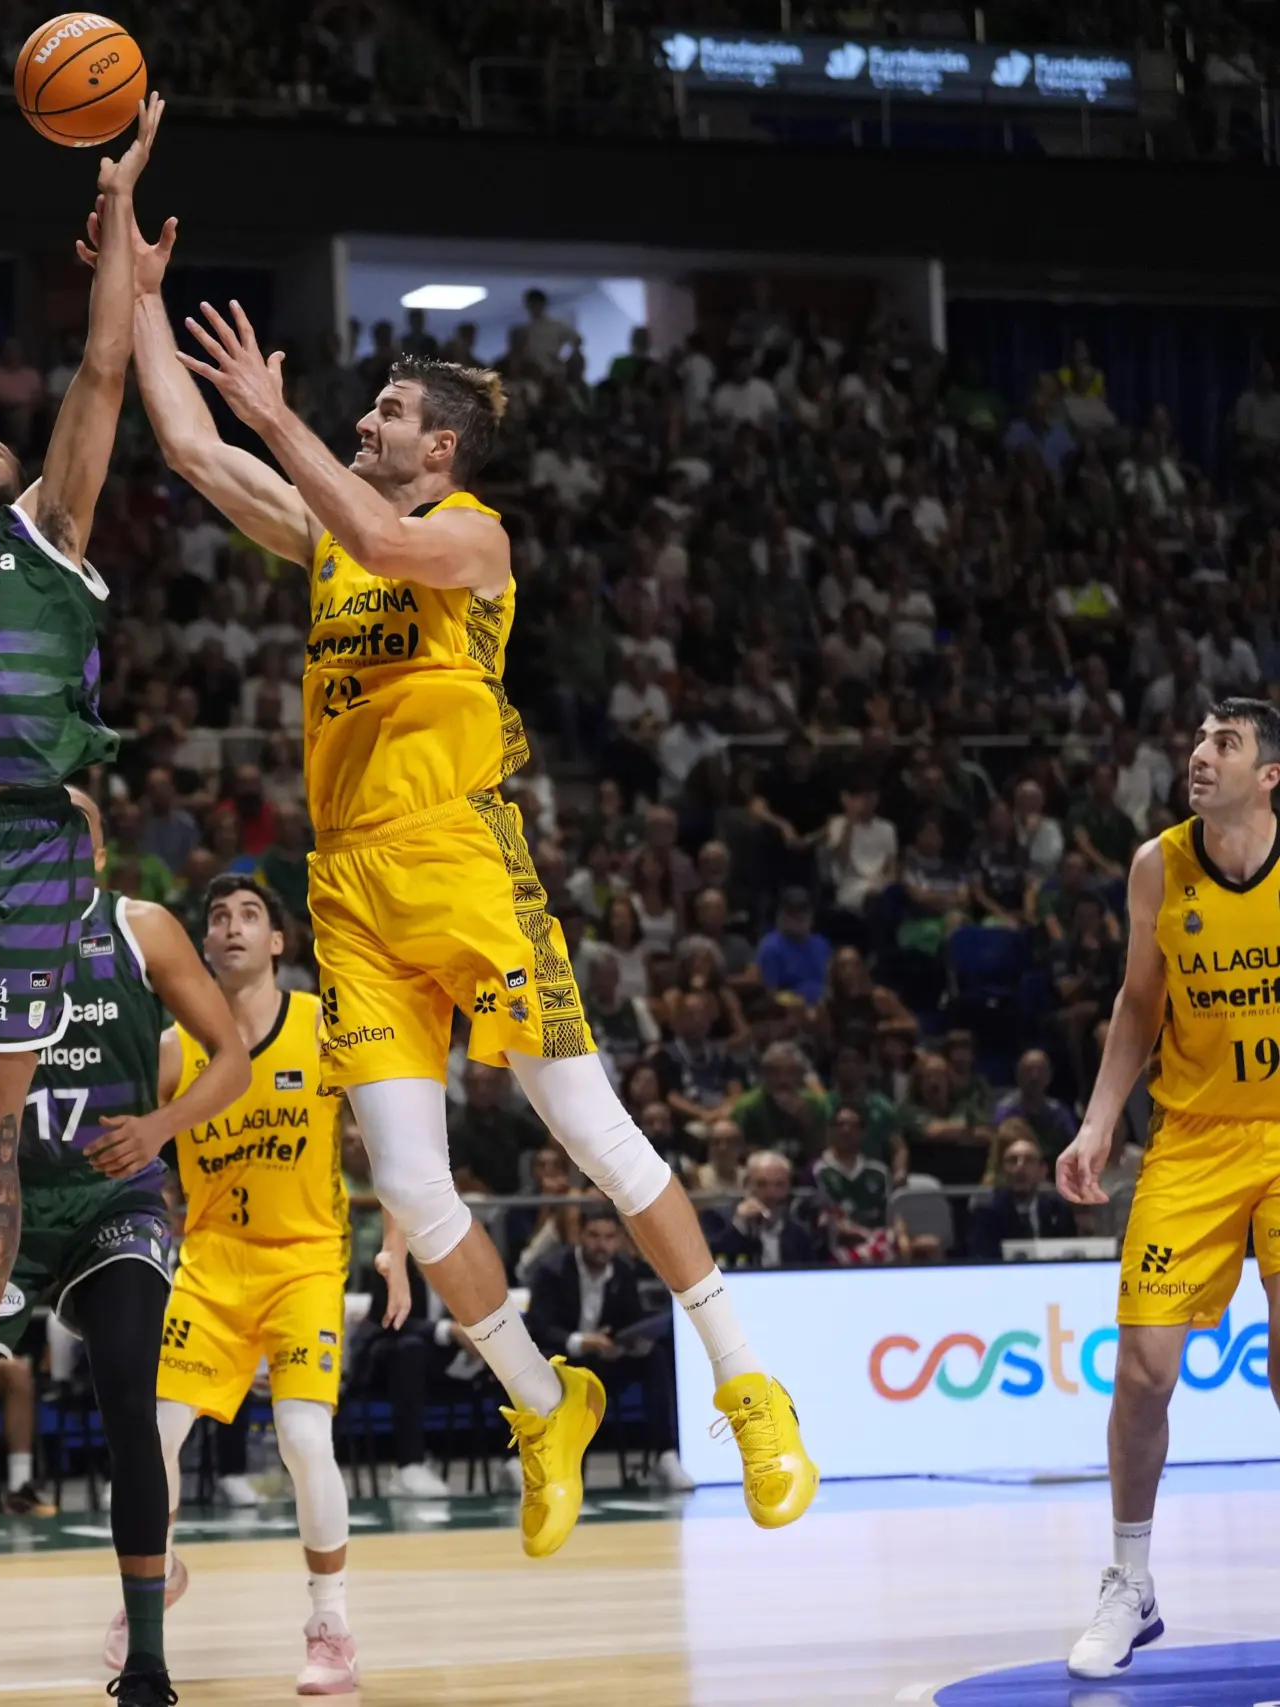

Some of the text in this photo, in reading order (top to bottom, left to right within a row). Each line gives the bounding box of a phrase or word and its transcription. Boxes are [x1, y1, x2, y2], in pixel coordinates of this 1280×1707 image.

[89, 52, 120, 75] acb
[325, 588, 419, 620] LAGUNA
[1178, 952, 1208, 974] LA
[32, 979, 47, 987] acb
[1231, 1037, 1280, 1084] 19
[26, 1086, 90, 1142] 17
[190, 1107, 309, 1144] LA LAGUNA
[231, 1187, 249, 1227] 3
